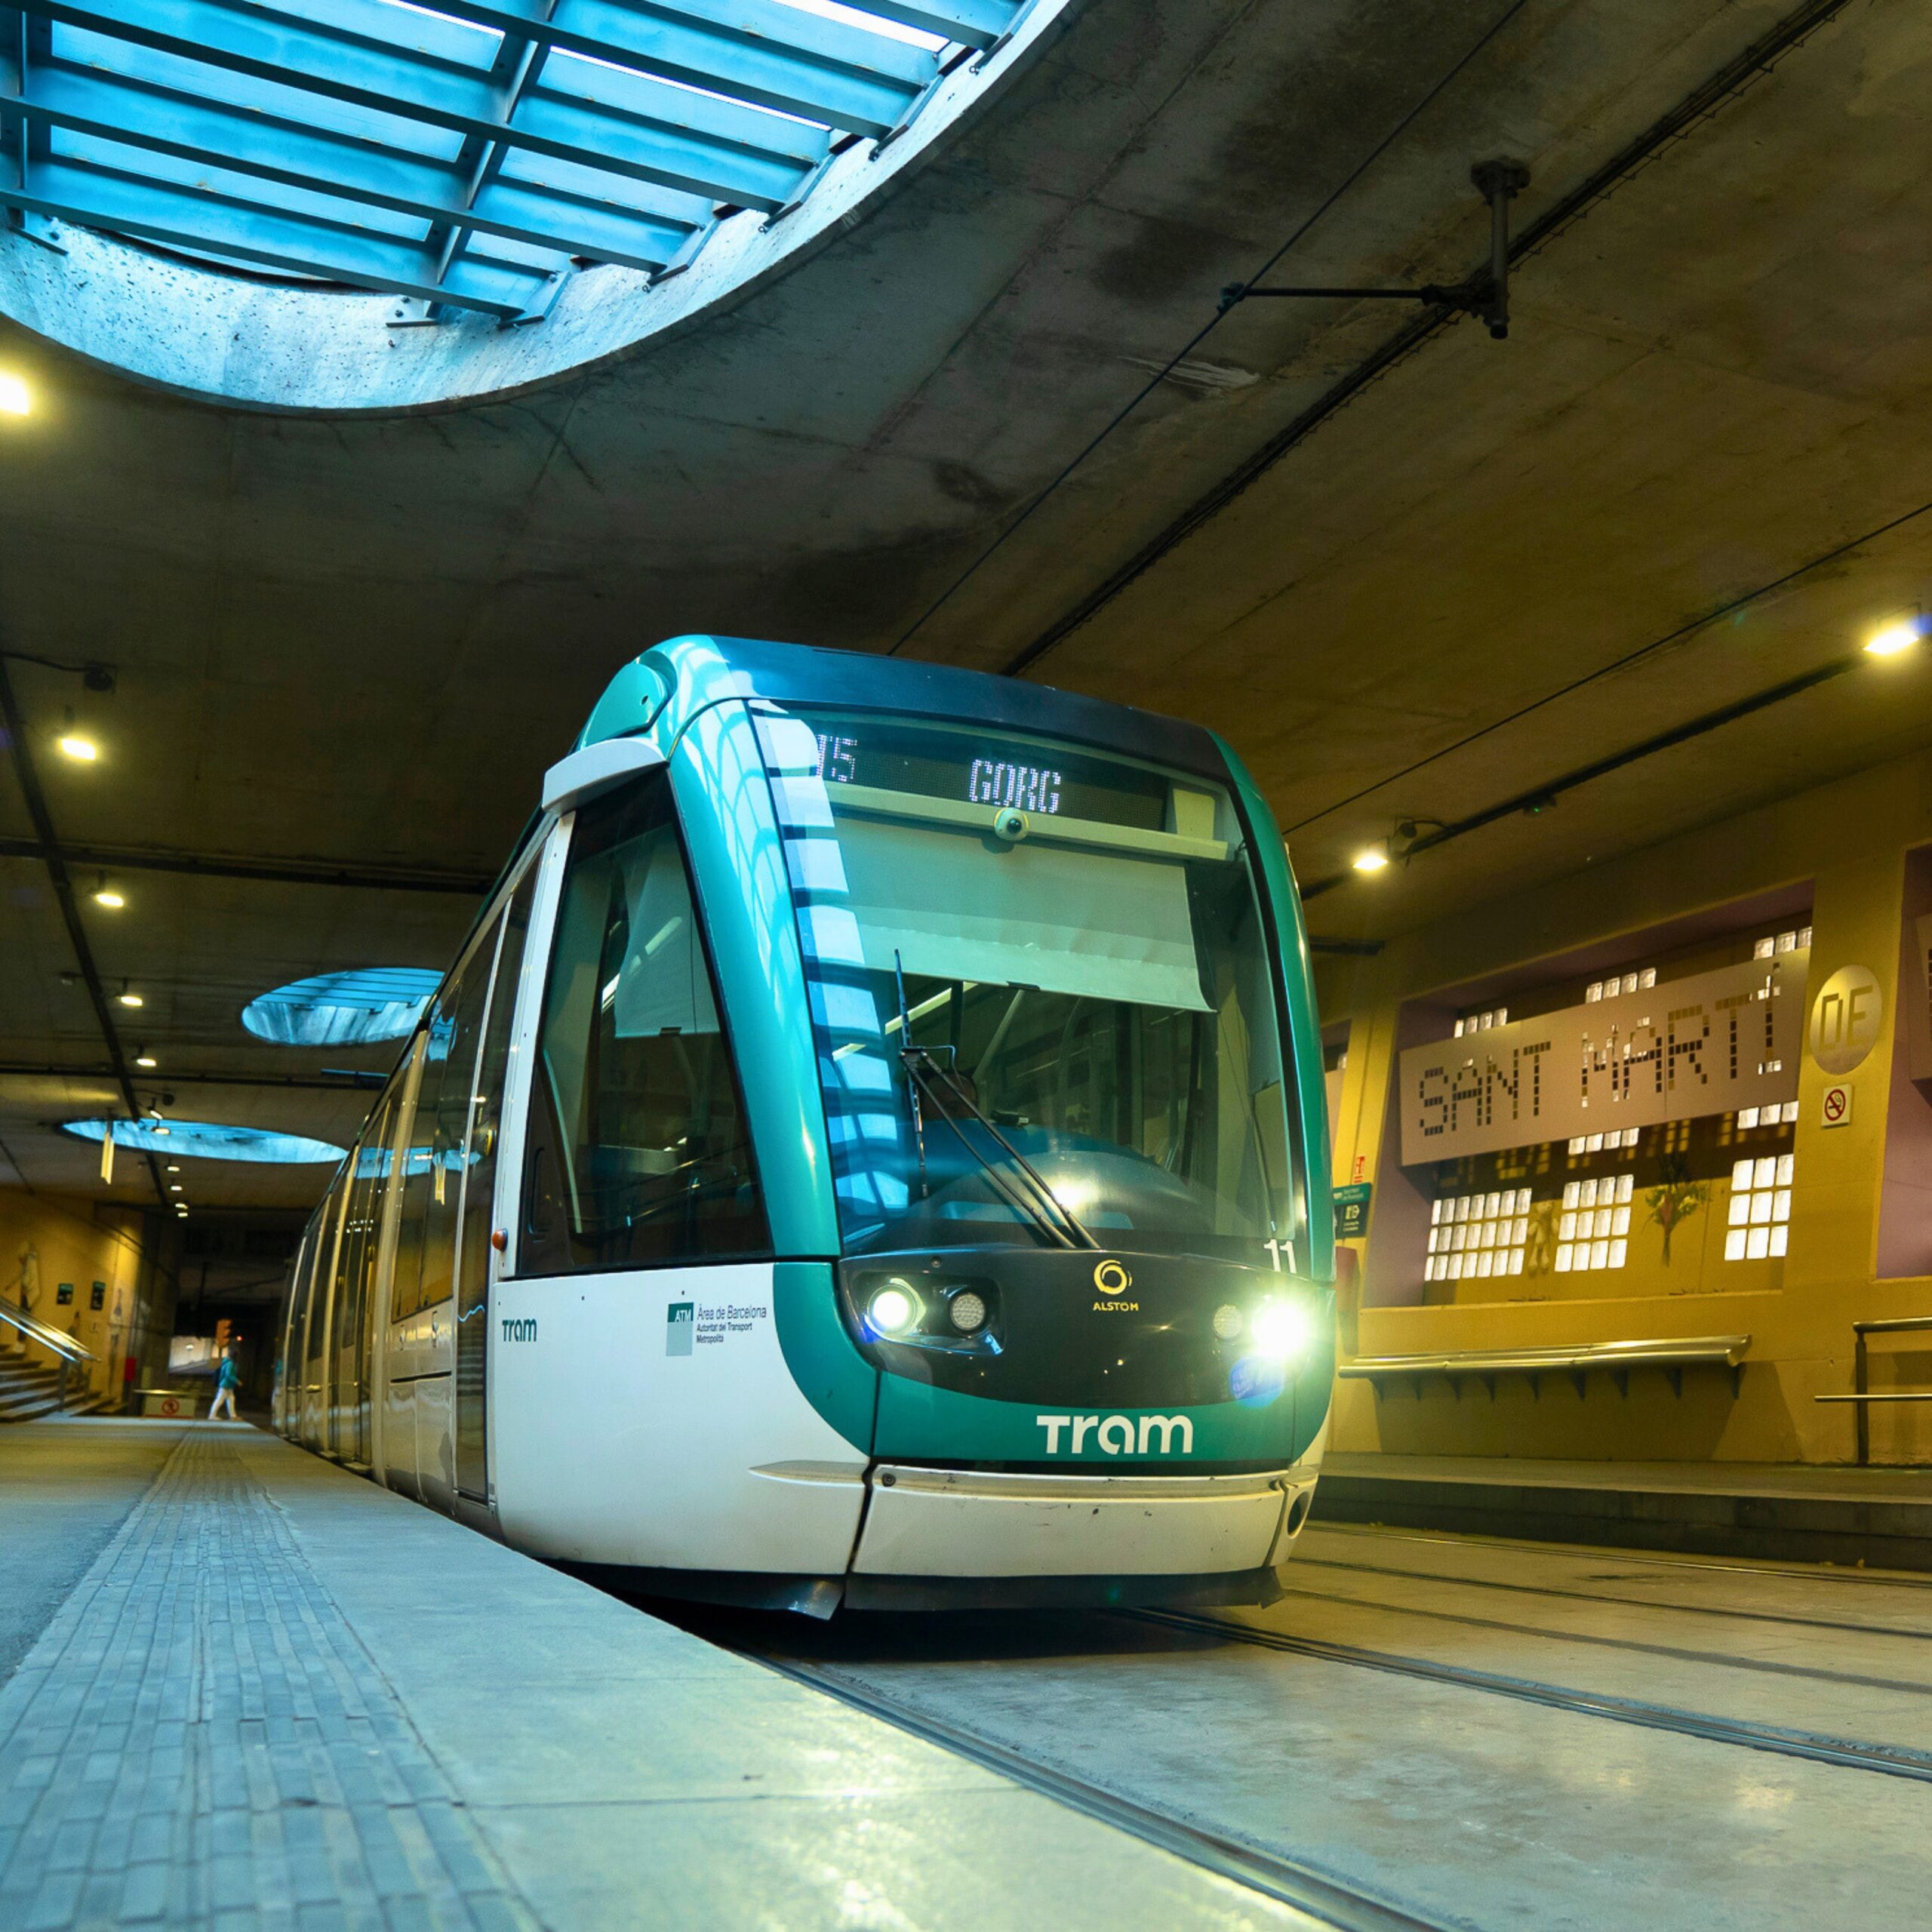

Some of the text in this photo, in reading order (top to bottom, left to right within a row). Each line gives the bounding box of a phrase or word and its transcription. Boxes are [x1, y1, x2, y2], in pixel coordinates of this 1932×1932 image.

[969, 759, 1061, 814] GORG
[1819, 984, 1873, 1051] DE
[1420, 1041, 1551, 1137] SANT
[1263, 1238, 1297, 1273] 11
[675, 1308, 691, 1322] ATM
[716, 1305, 725, 1319] de
[727, 1305, 767, 1319] Barcelona
[1093, 1302, 1140, 1312] ALSTOM
[697, 1323, 718, 1332] Autoritat
[728, 1322, 752, 1332] Transport
